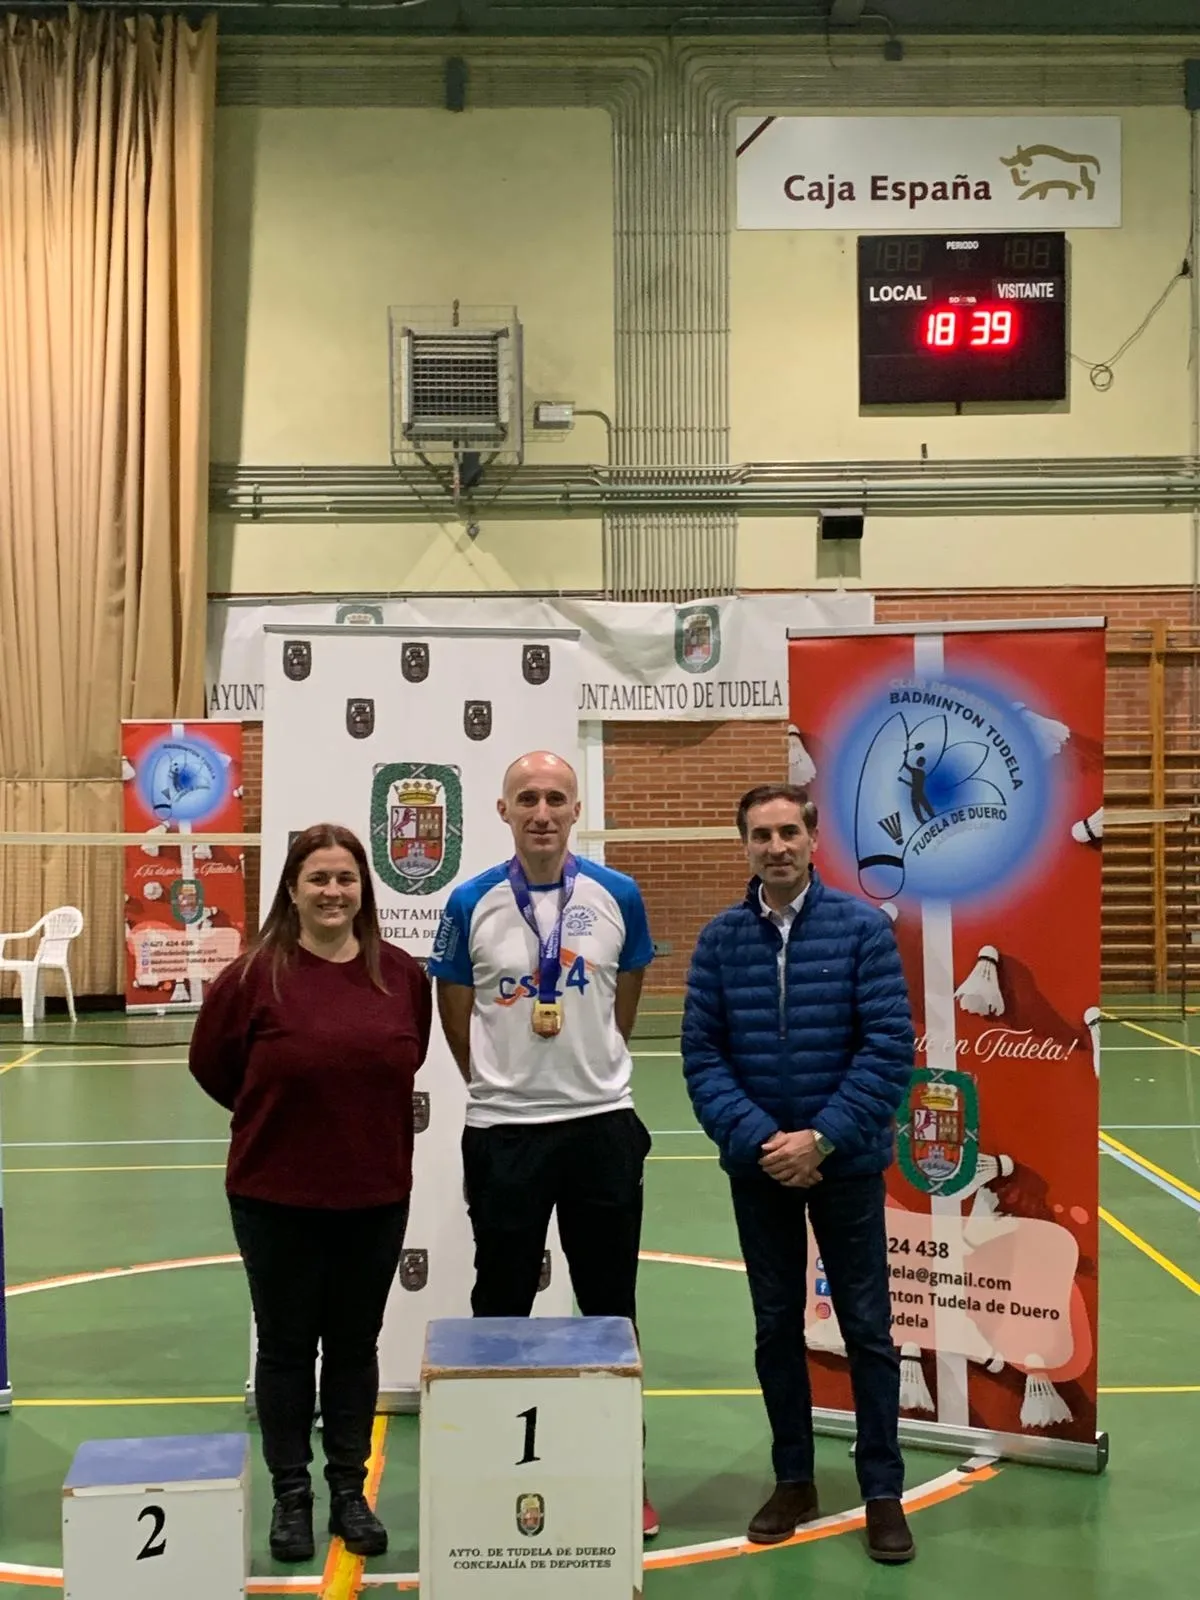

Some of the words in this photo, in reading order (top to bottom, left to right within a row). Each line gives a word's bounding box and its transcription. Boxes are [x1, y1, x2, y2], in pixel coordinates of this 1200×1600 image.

[784, 174, 856, 210] Caja
[870, 174, 992, 210] España
[946, 240, 980, 250] PERIODO
[869, 285, 928, 302] LOCAL
[997, 282, 1055, 299] VISITANTE
[926, 312, 956, 346] 18
[970, 311, 1012, 345] 39
[693, 681, 714, 709] DE
[718, 680, 784, 708] TUDELA
[889, 690, 986, 729] BADMINTON
[985, 724, 1024, 791] TUDELA
[912, 818, 950, 856] TUDELA
[949, 808, 967, 825] DE
[967, 806, 1008, 821] DUERO
[975, 1027, 1079, 1064] Tudela!
[915, 1240, 950, 1259] 438
[928, 1292, 982, 1312] Tudela
[985, 1299, 1006, 1315] de
[1010, 1302, 1061, 1321] Duero
[515, 1406, 541, 1466] 1
[136, 1504, 167, 1561] 2
[449, 1549, 484, 1558] AYTO.
[488, 1549, 504, 1557] DE
[507, 1548, 553, 1558] TUDELA
[556, 1547, 573, 1557] DE
[576, 1547, 617, 1557] DUERO
[453, 1558, 527, 1570] CONCEJALÍA
[530, 1560, 547, 1569] DE
[550, 1559, 612, 1569] DEPORTES
